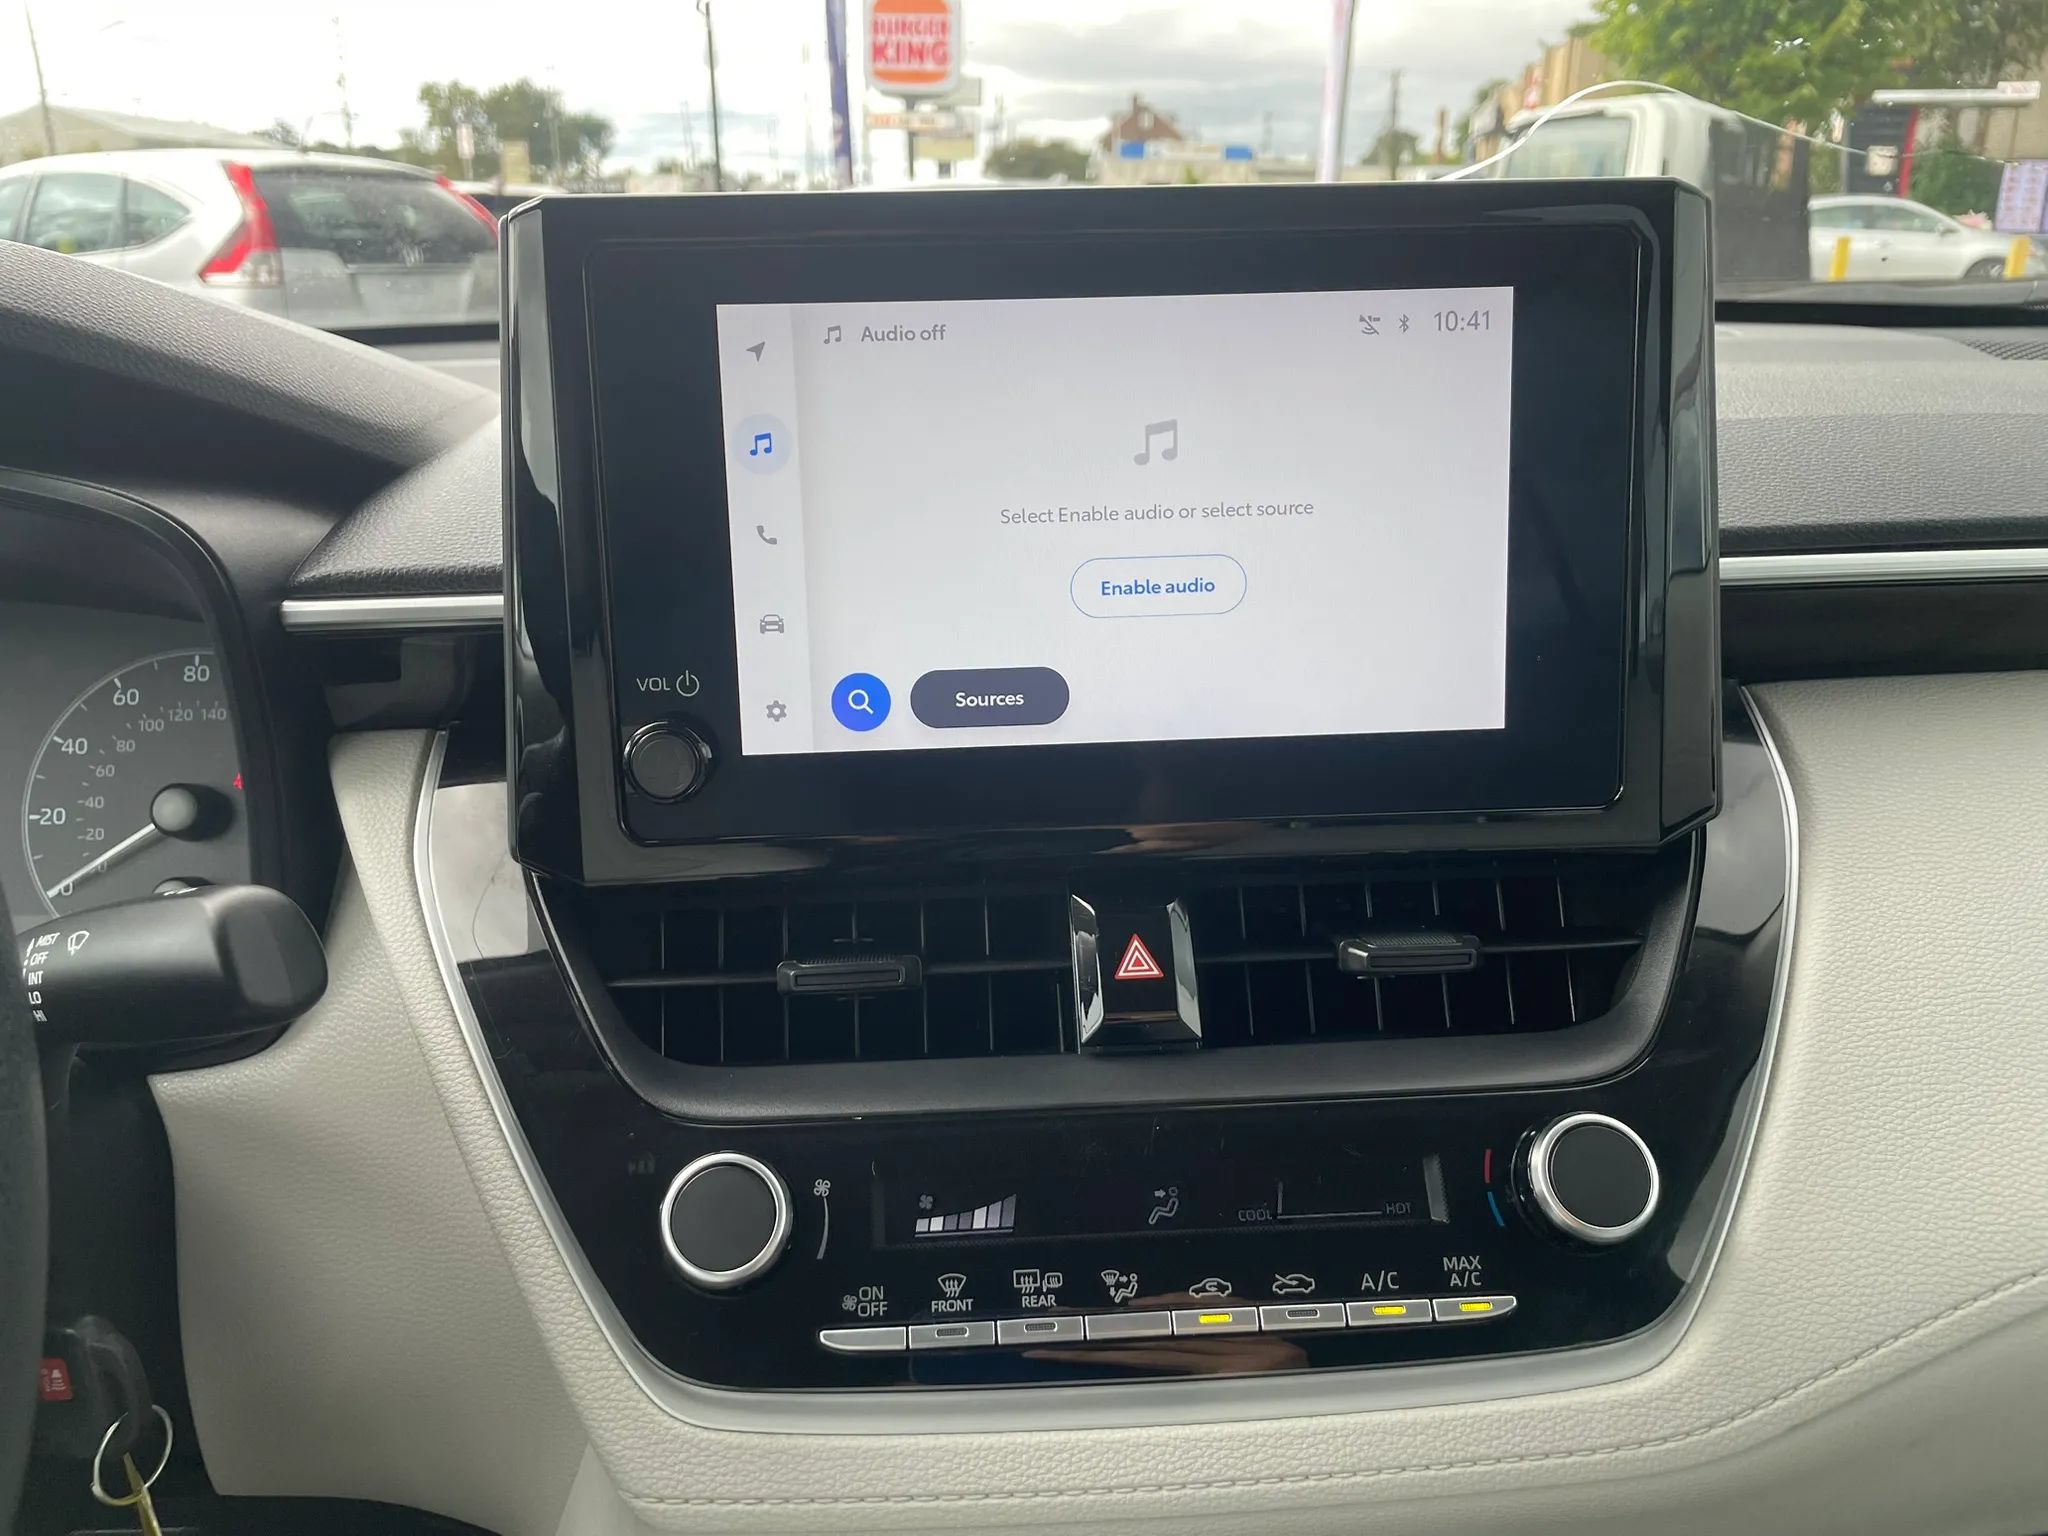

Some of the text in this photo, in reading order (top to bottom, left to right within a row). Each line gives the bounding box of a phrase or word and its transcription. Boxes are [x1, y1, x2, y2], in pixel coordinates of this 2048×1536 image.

[873, 41, 948, 65] KING
[1433, 310, 1490, 332] 10:41
[861, 324, 946, 342] Audio off
[1000, 502, 1314, 524] Select Enable audio or select source
[1101, 577, 1215, 596] Enable audio
[183, 665, 210, 682] 80
[636, 677, 671, 691] VOL
[113, 688, 139, 706] 60
[955, 692, 1024, 707] Sources
[168, 709, 193, 721] 120
[201, 708, 227, 720] 140
[138, 719, 164, 732] 100
[61, 738, 88, 755] 40
[116, 740, 136, 752] 80
[96, 765, 115, 777] 60
[85, 796, 104, 809] 40
[40, 807, 66, 825] 20
[85, 828, 104, 840] 20
[35, 932, 60, 948] MIST
[30, 951, 49, 966] OFF
[28, 971, 43, 986] INT
[28, 991, 42, 1004] LO
[1238, 1208, 1273, 1222] COOL
[1385, 1202, 1412, 1215] HOT
[1443, 1255, 1482, 1271] MAX
[1361, 1270, 1400, 1292] A/C
[1449, 1272, 1482, 1288] A/C
[859, 1286, 884, 1301] ON
[857, 1301, 888, 1317] OFF
[931, 1298, 974, 1313] FRONT
[1022, 1295, 1057, 1308] REAR
